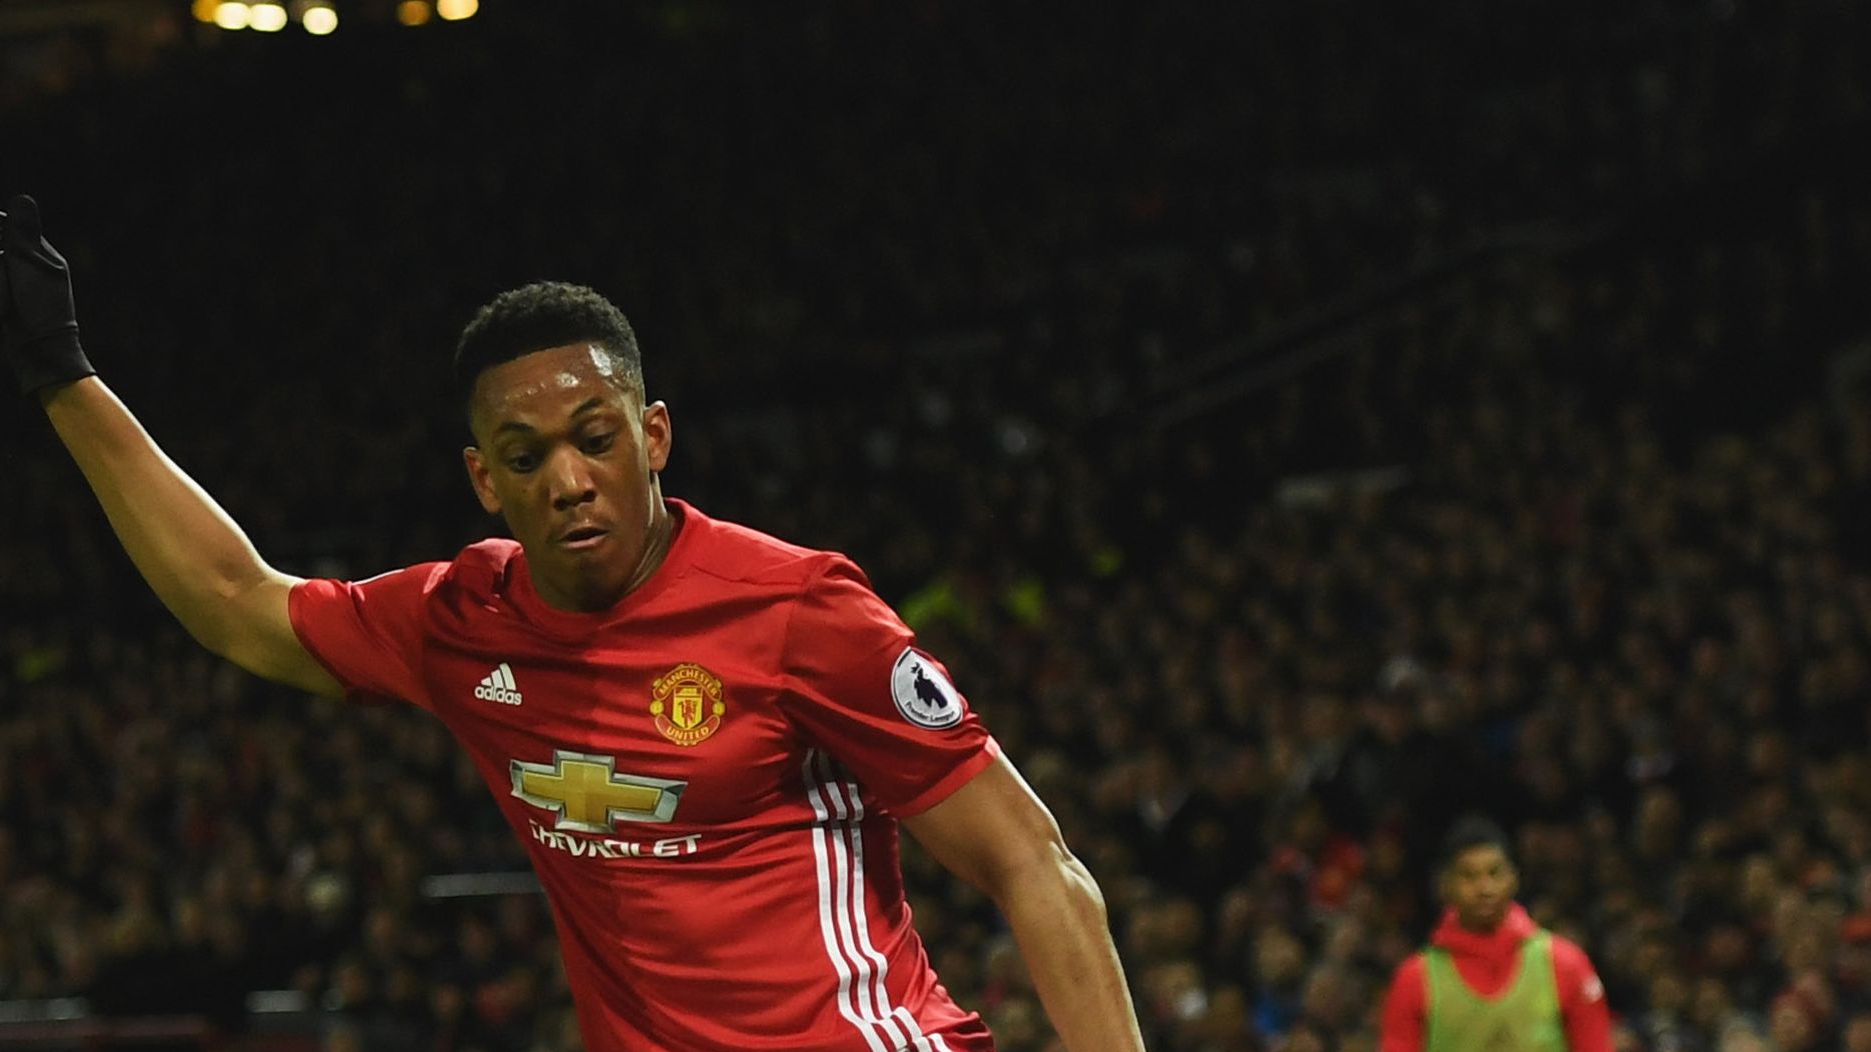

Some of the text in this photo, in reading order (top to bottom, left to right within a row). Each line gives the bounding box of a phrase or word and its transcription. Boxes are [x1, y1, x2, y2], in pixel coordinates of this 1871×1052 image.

[658, 669, 719, 696] MANCHESTER
[474, 686, 522, 706] adidas
[666, 725, 710, 740] UNITED
